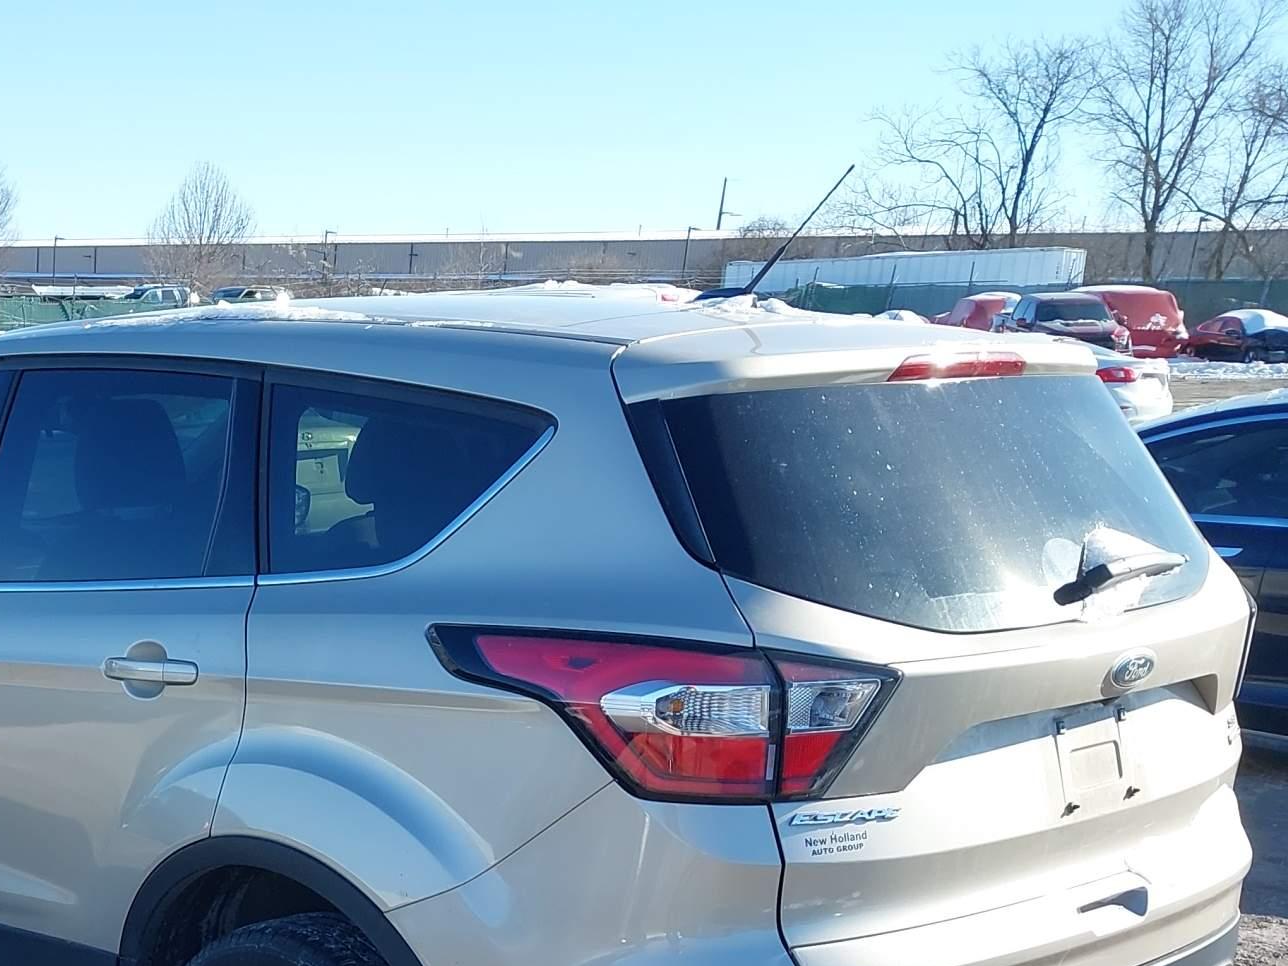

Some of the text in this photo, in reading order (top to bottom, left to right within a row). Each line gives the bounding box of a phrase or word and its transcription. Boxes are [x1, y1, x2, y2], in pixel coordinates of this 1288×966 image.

[1124, 658, 1150, 681] Ford
[789, 807, 902, 826] ESCAPE
[805, 830, 868, 847] New Holland
[811, 842, 864, 857] AUTO GROUP
